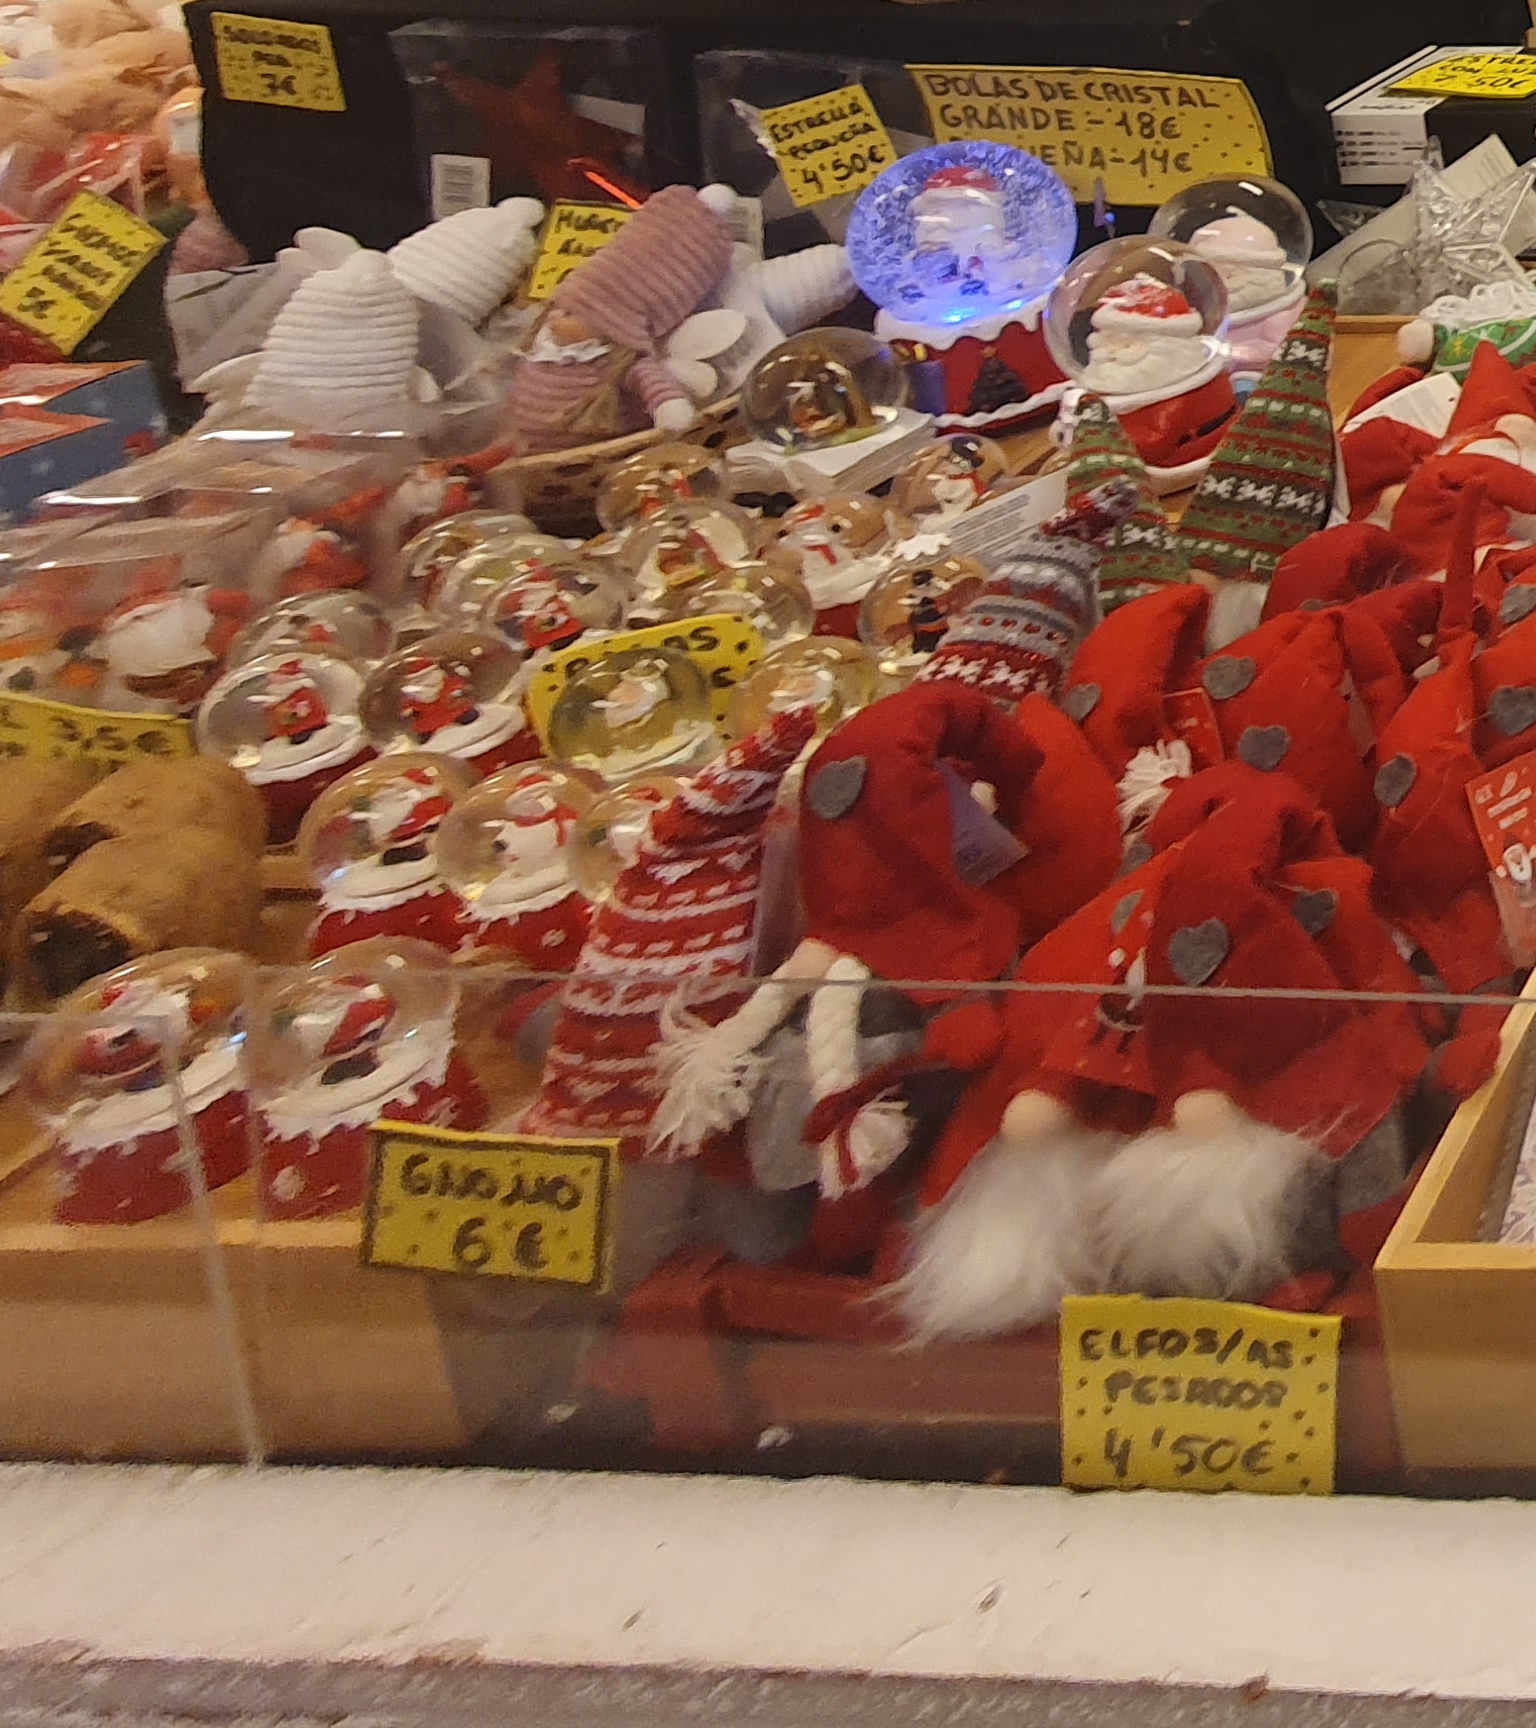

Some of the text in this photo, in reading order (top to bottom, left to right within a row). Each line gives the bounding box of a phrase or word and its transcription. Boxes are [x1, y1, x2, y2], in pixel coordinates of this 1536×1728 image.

[924, 73, 1222, 110] BOLAS DE CRISTAL
[769, 101, 864, 143] ESTRELLA
[940, 103, 1076, 131] GRANDE
[1114, 110, 1181, 140] 18€
